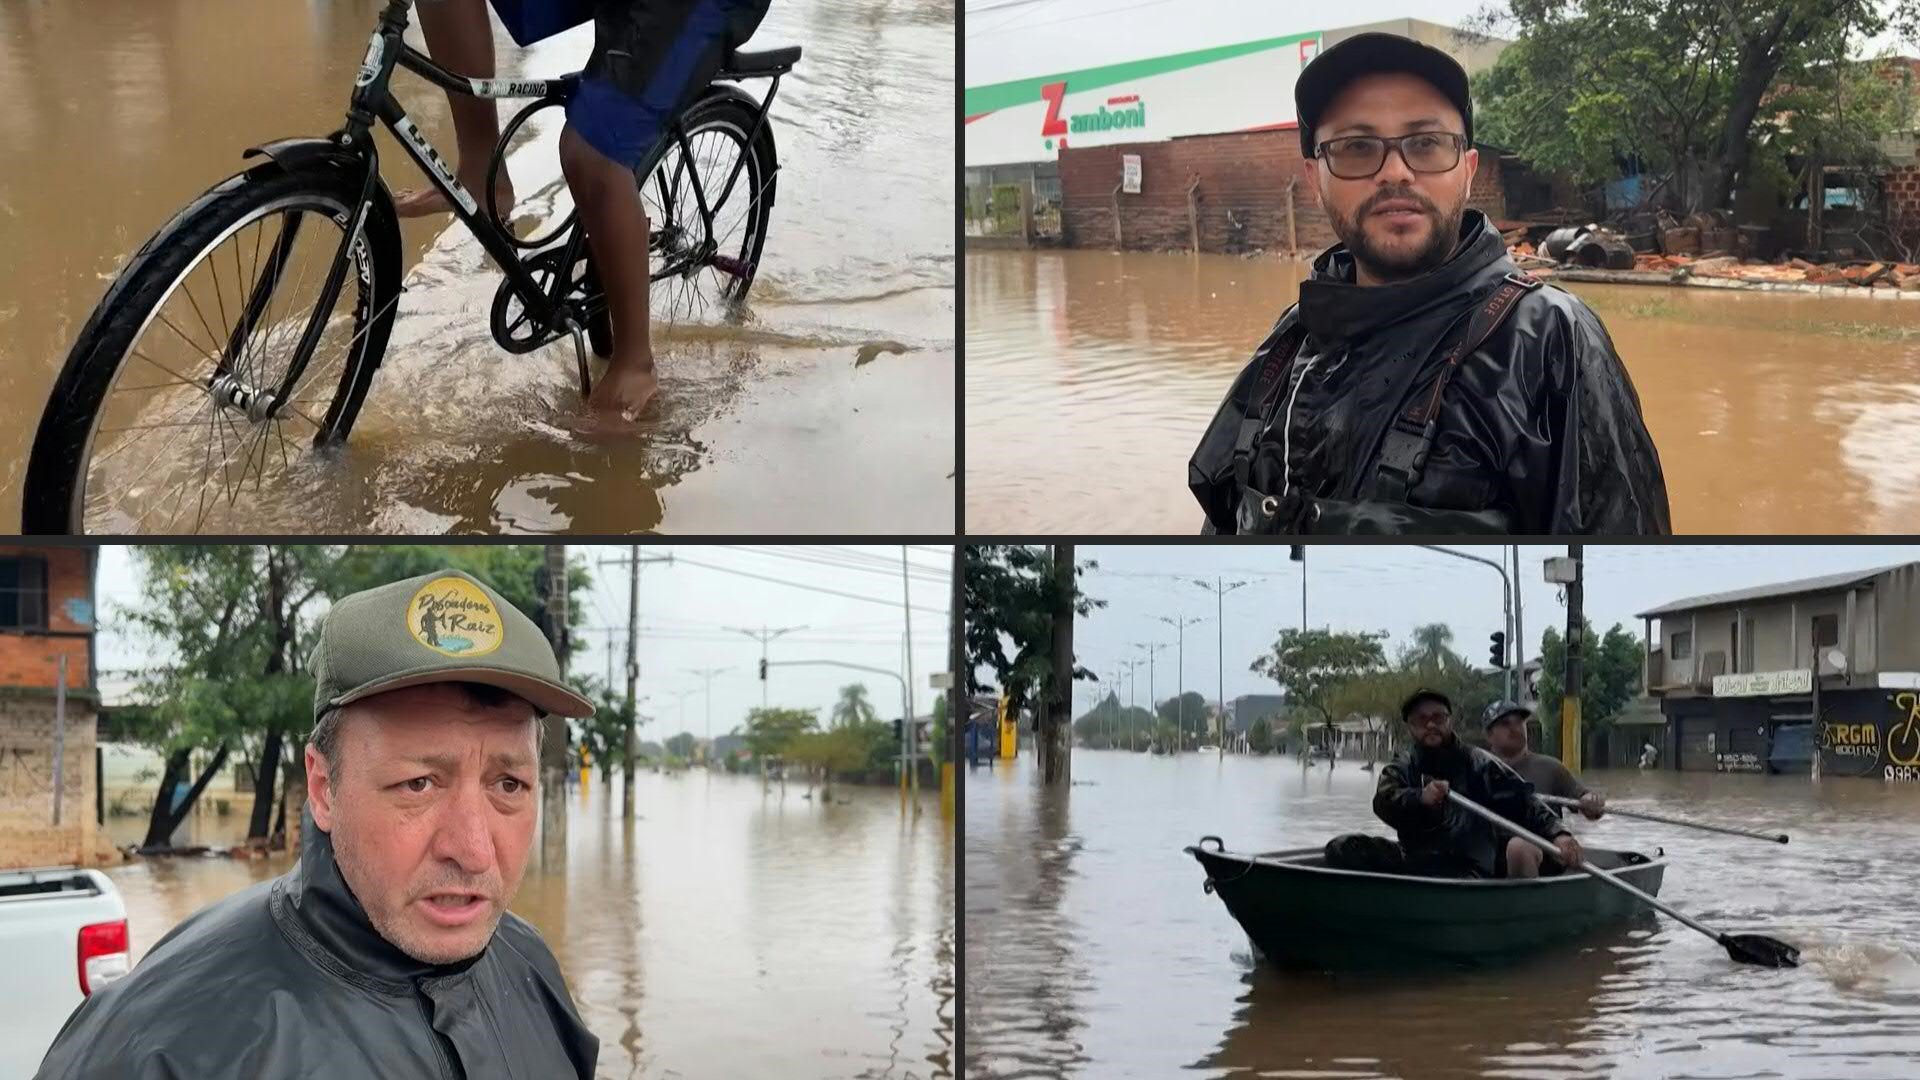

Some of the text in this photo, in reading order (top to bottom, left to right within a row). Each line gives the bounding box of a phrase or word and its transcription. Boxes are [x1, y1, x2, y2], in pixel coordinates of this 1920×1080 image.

[508, 83, 546, 95] RACING
[1041, 80, 1145, 136] Zamboni
[449, 614, 495, 634] Raiz
[1837, 723, 1875, 744] RGM
